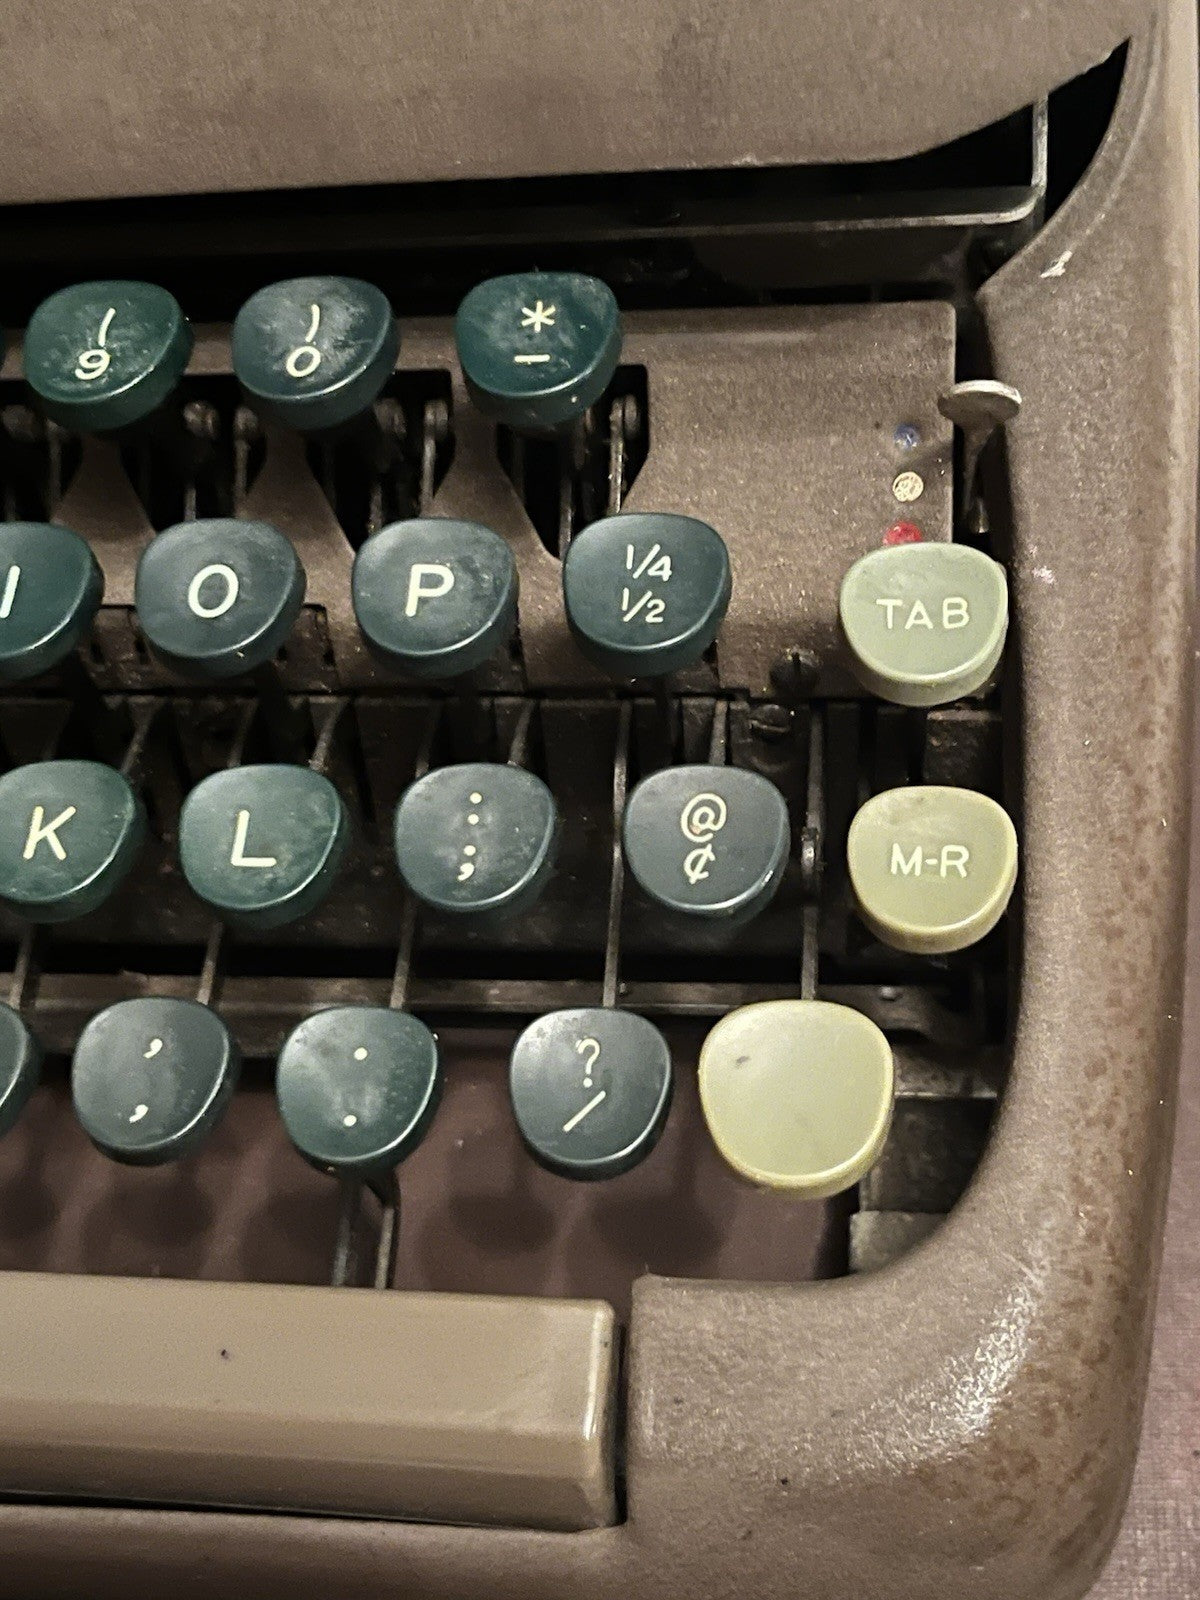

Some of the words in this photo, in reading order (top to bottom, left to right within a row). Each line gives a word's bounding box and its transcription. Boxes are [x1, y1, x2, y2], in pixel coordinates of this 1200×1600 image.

[75, 348, 110, 381] 9
[188, 564, 239, 618] O
[405, 563, 454, 618] P
[876, 597, 970, 630] TAB
[23, 806, 76, 860] K
[230, 810, 277, 867] L
[681, 793, 727, 841] @
[891, 843, 970, 878] M-R
[576, 1037, 601, 1087] ?
[563, 1091, 606, 1132] /
